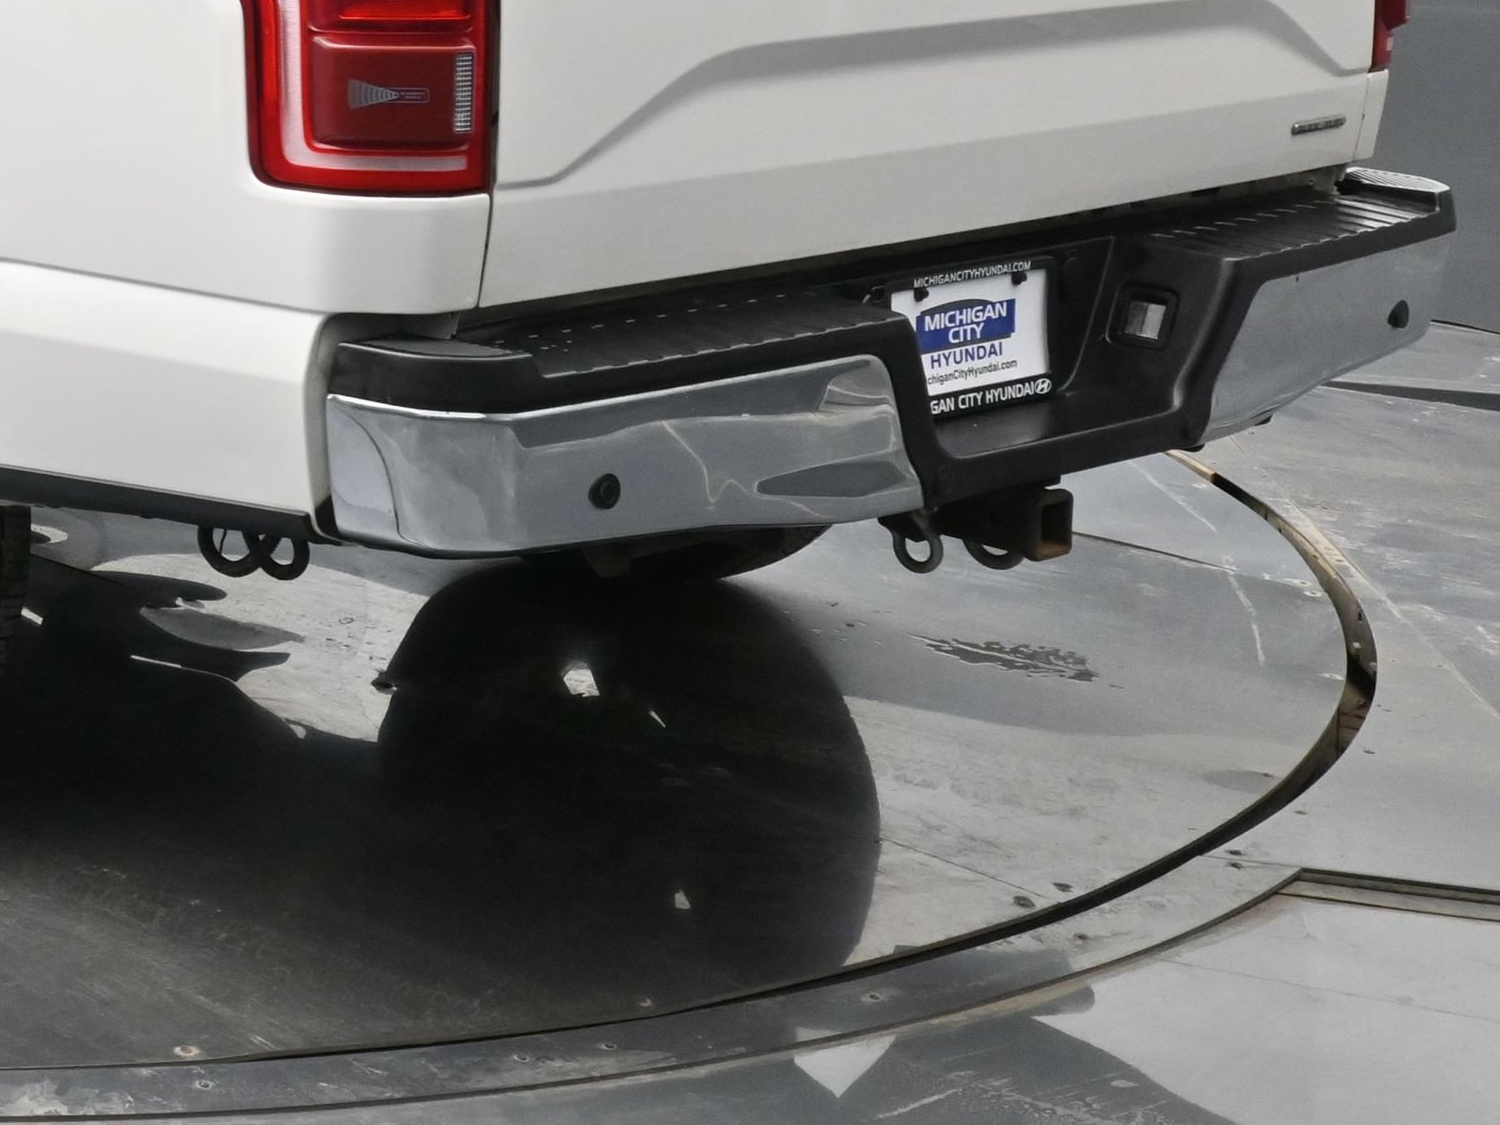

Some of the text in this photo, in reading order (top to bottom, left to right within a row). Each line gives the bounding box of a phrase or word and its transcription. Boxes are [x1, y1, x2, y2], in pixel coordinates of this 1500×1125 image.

[913, 260, 1032, 288] MICHIGANCITYHYUNDAI.COM
[924, 301, 1008, 332] MICHIGAN
[948, 322, 985, 344] CITY
[930, 341, 1003, 370] HYUNDAI
[958, 391, 983, 409] CITY
[985, 381, 1035, 404] HYUNDAI
